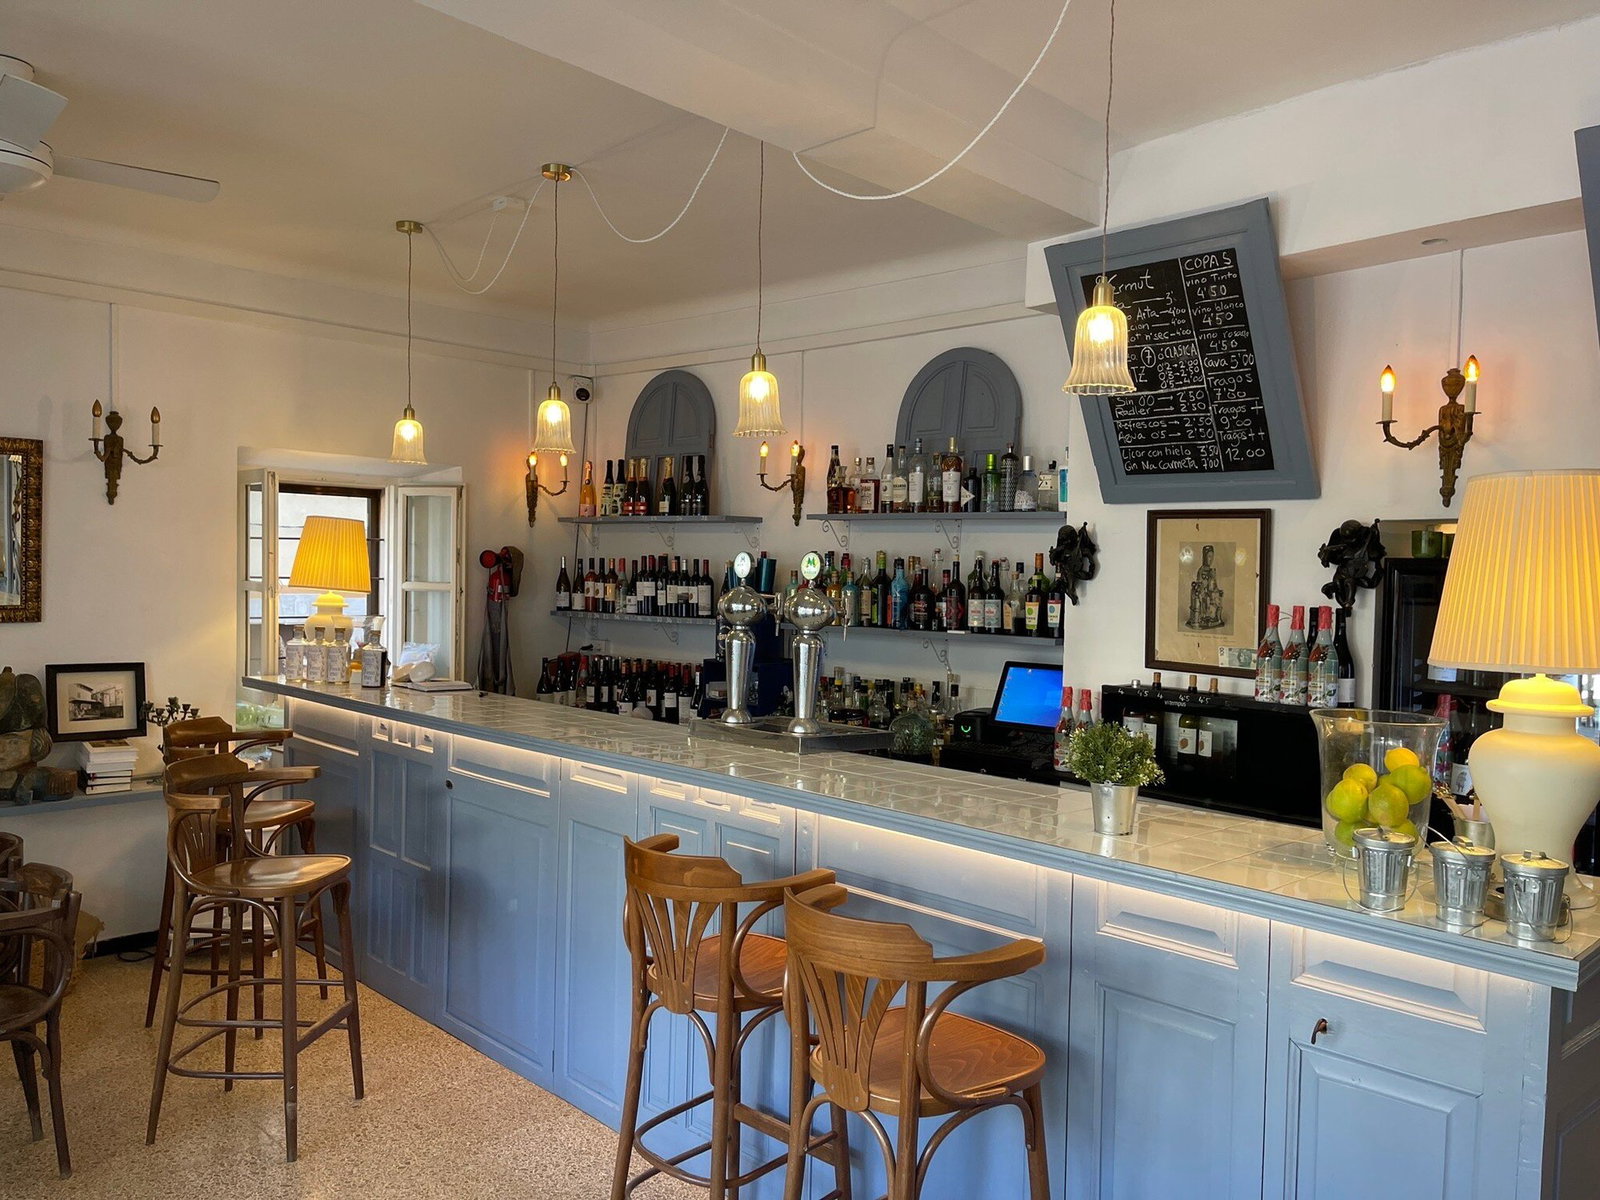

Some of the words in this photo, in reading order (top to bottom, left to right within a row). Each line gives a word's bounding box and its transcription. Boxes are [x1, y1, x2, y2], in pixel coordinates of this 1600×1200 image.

[1186, 277, 1207, 287] vino
[1210, 272, 1237, 282] Tinto
[1215, 302, 1244, 311] blanco
[1207, 373, 1253, 391] Tragos
[1116, 397, 1134, 407] Sin
[1115, 406, 1150, 418] Radler
[1212, 404, 1246, 419] Tragos
[1117, 420, 1167, 431] Refrescos
[1118, 431, 1146, 443] Agua
[1122, 449, 1145, 459] Licor
[1148, 449, 1163, 457] con
[1165, 445, 1191, 456] hielo
[1124, 461, 1138, 471] Gin
